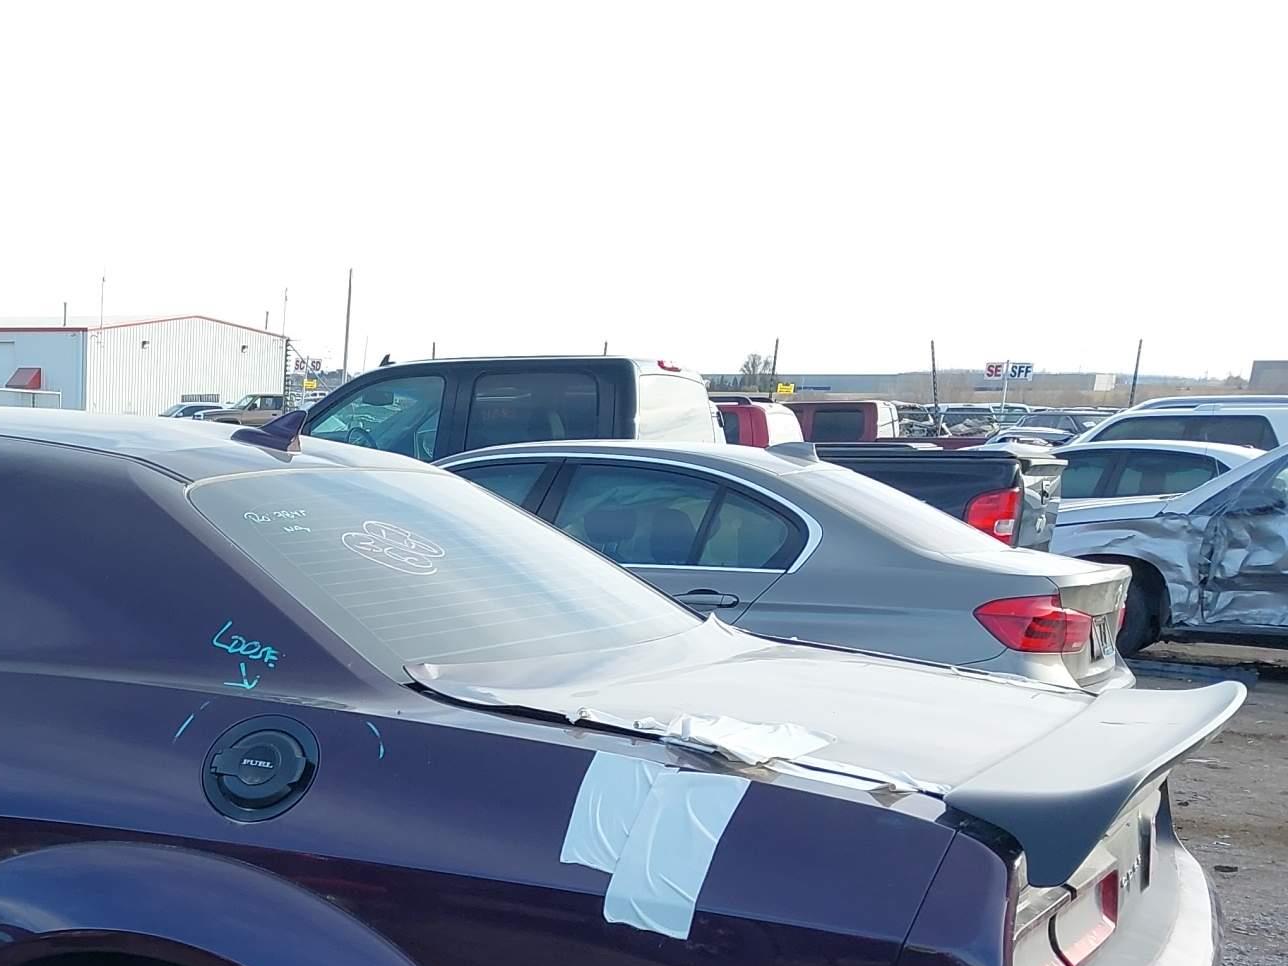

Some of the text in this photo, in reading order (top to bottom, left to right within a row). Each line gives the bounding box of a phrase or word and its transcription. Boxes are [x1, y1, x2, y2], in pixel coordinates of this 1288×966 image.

[294, 359, 306, 371] SC
[310, 359, 322, 372] SD
[986, 364, 1003, 378] SE
[1009, 365, 1032, 378] SFF
[212, 620, 279, 668] LOOSE
[240, 757, 274, 769] FUEL
